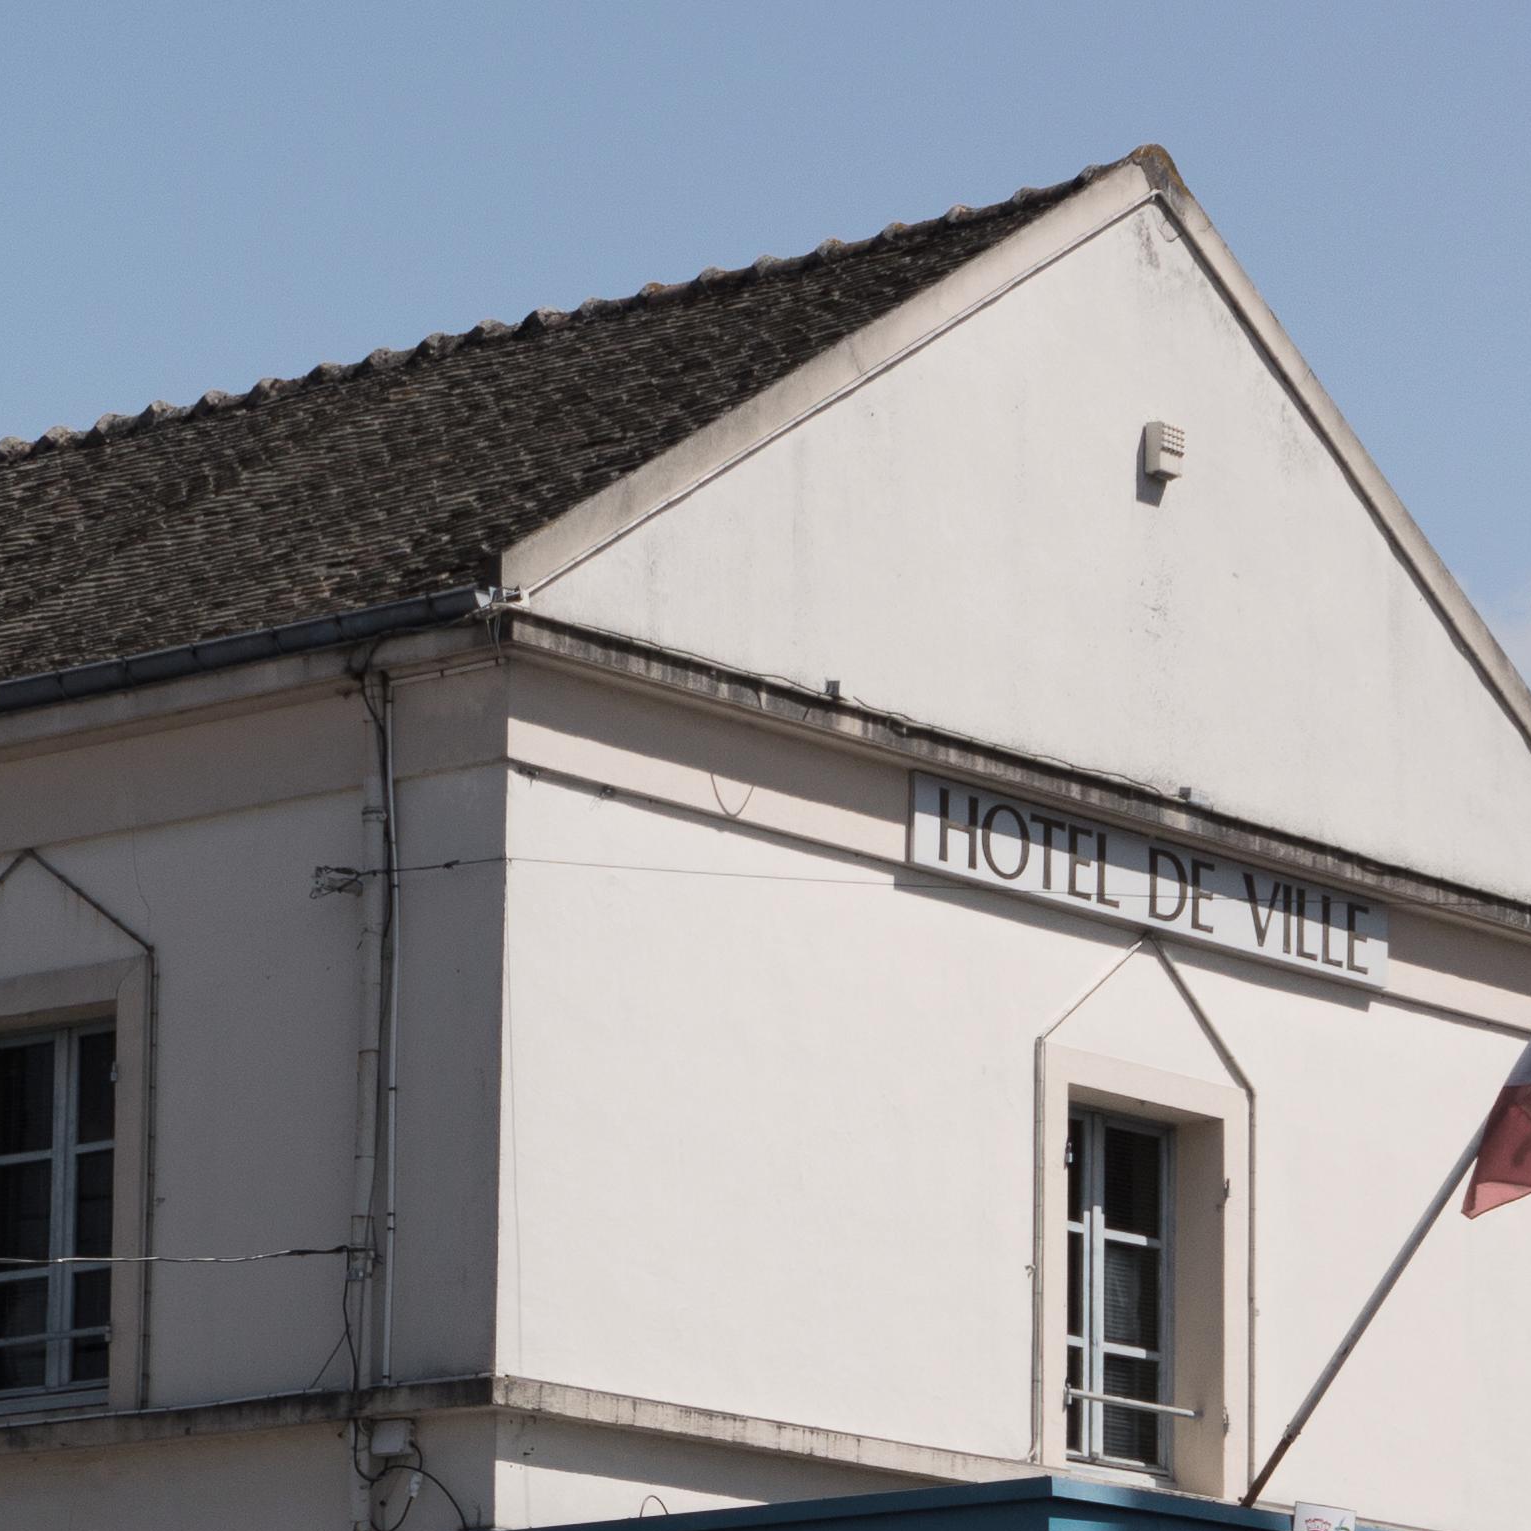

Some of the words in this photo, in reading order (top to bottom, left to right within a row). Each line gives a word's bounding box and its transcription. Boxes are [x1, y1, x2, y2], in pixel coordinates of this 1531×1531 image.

[938, 787, 1120, 909] HOTEL
[1147, 847, 1215, 934] DE
[1242, 872, 1370, 975] VILLE
